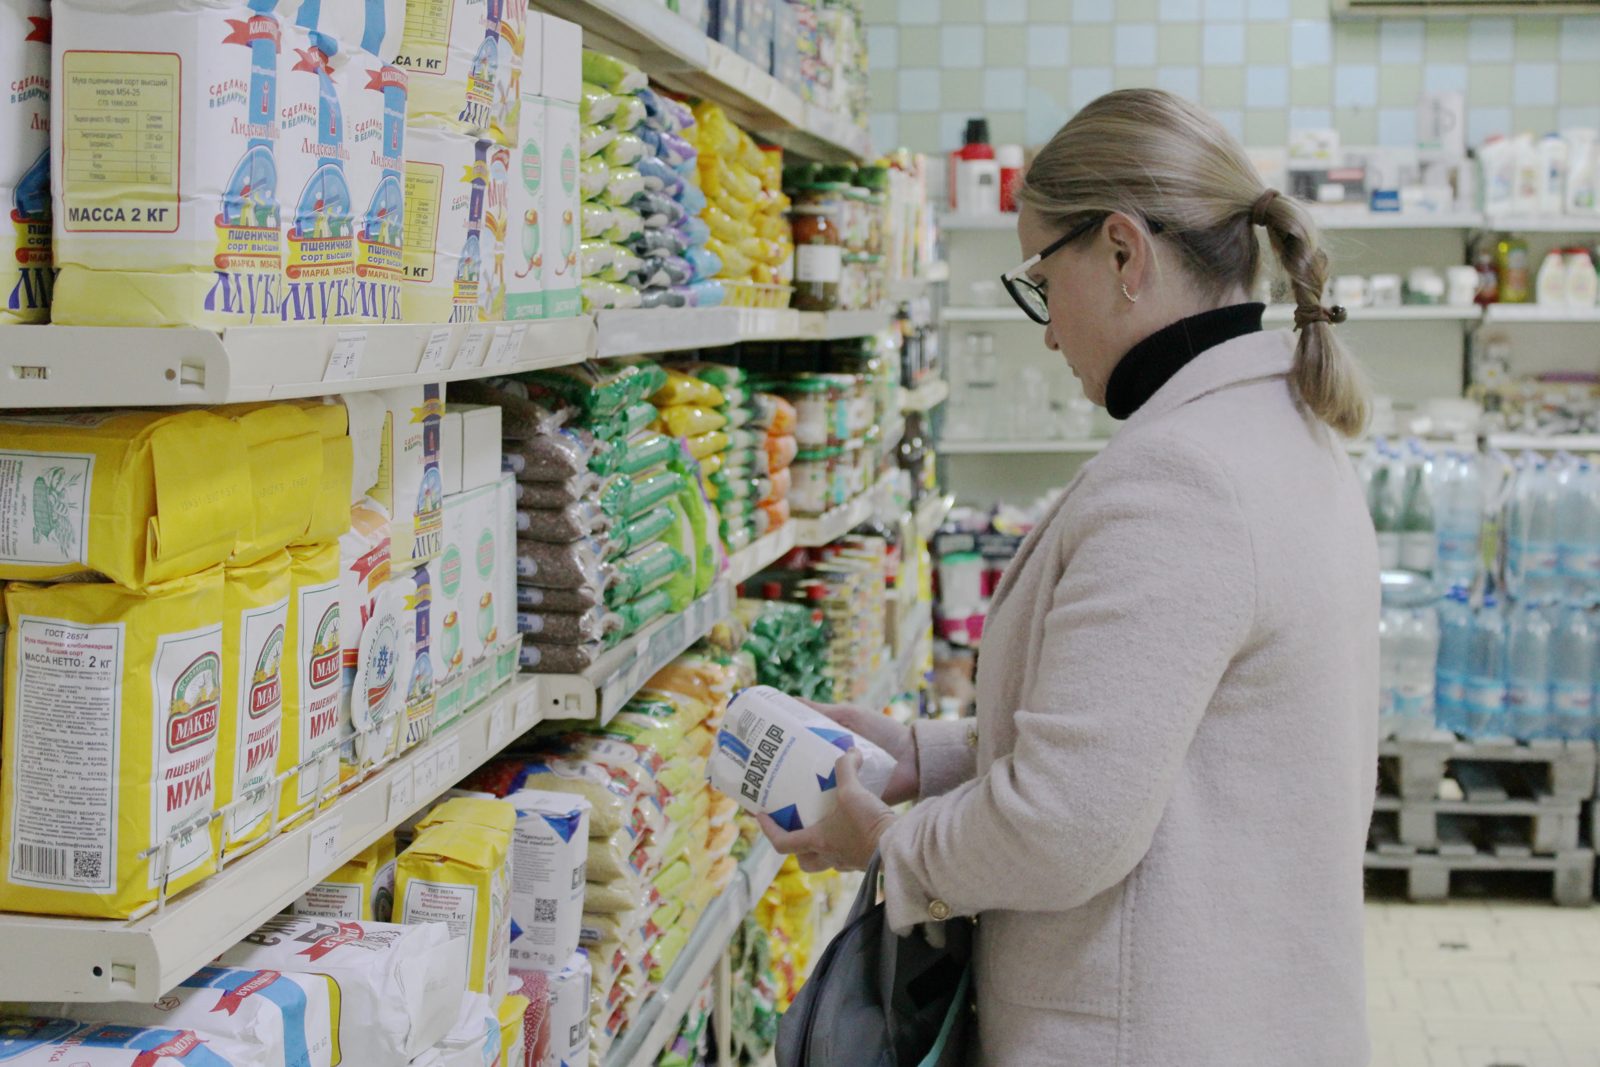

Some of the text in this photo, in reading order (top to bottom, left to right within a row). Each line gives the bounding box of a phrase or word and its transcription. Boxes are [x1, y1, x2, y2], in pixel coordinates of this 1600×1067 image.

[416, 57, 422, 67] 1
[426, 58, 442, 70] КГ
[209, 79, 248, 97] СДЕЛАНО
[282, 102, 317, 119] СДЕЛАНО
[355, 118, 383, 133] СДЕЛАНО
[68, 207, 169, 222] МАССА 2 КГ
[227, 242, 248, 253] сорт
[230, 258, 256, 269] МАРКА
[300, 253, 324, 263] сорт
[368, 255, 385, 266] сорт
[302, 267, 330, 278] МАРКА
[413, 267, 429, 278] КГ
[45, 628, 89, 640] ГОСТ 26574
[25, 652, 51, 664] МАССА
[88, 655, 97, 668] 2
[100, 659, 113, 668] КГ
[175, 709, 216, 741] MAKFA
[740, 723, 785, 804] САХАР
[166, 767, 212, 813] МУКА
[411, 909, 430, 917] МАССА
[452, 911, 457, 919] 1
